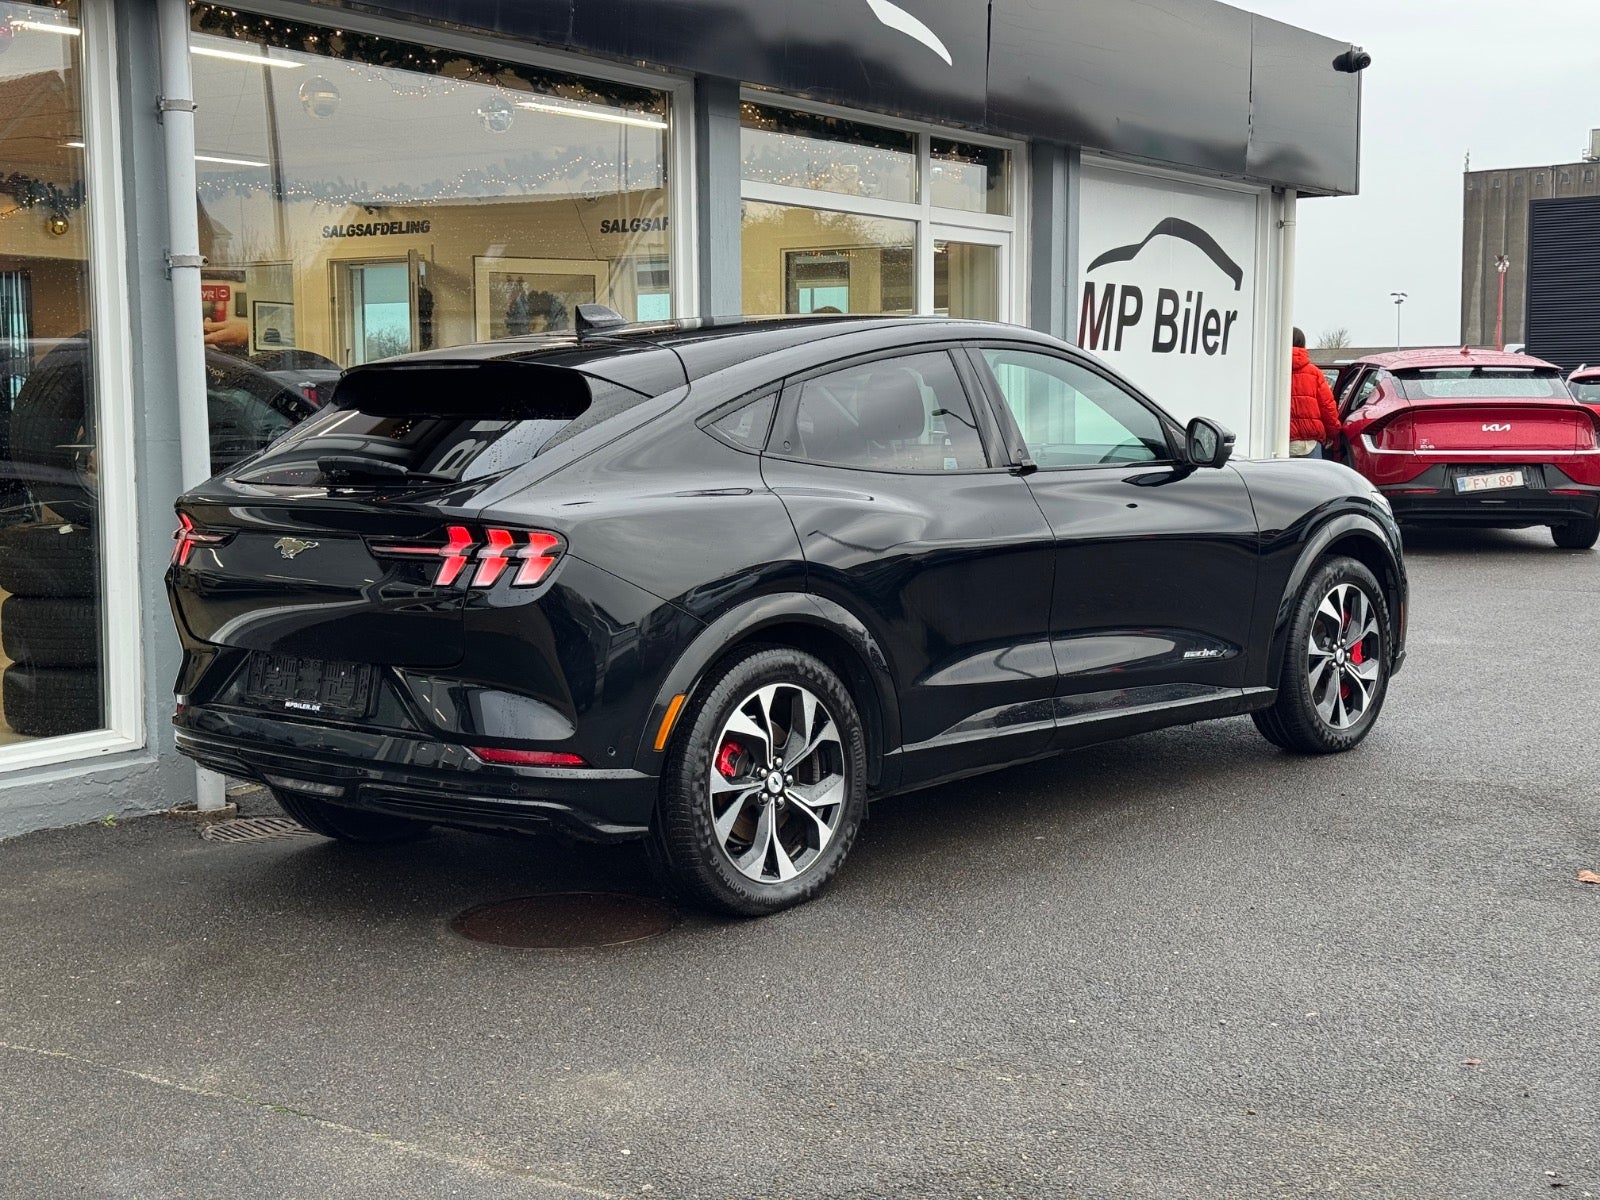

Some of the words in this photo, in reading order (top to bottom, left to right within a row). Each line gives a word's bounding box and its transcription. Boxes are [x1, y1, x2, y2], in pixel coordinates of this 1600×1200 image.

[322, 219, 431, 239] SALGSAFDELING
[1078, 281, 1144, 352] MP
[1152, 288, 1238, 356] Biler
[1481, 423, 1511, 432] KIA
[1473, 477, 1489, 489] FY
[1498, 474, 1514, 487] 89
